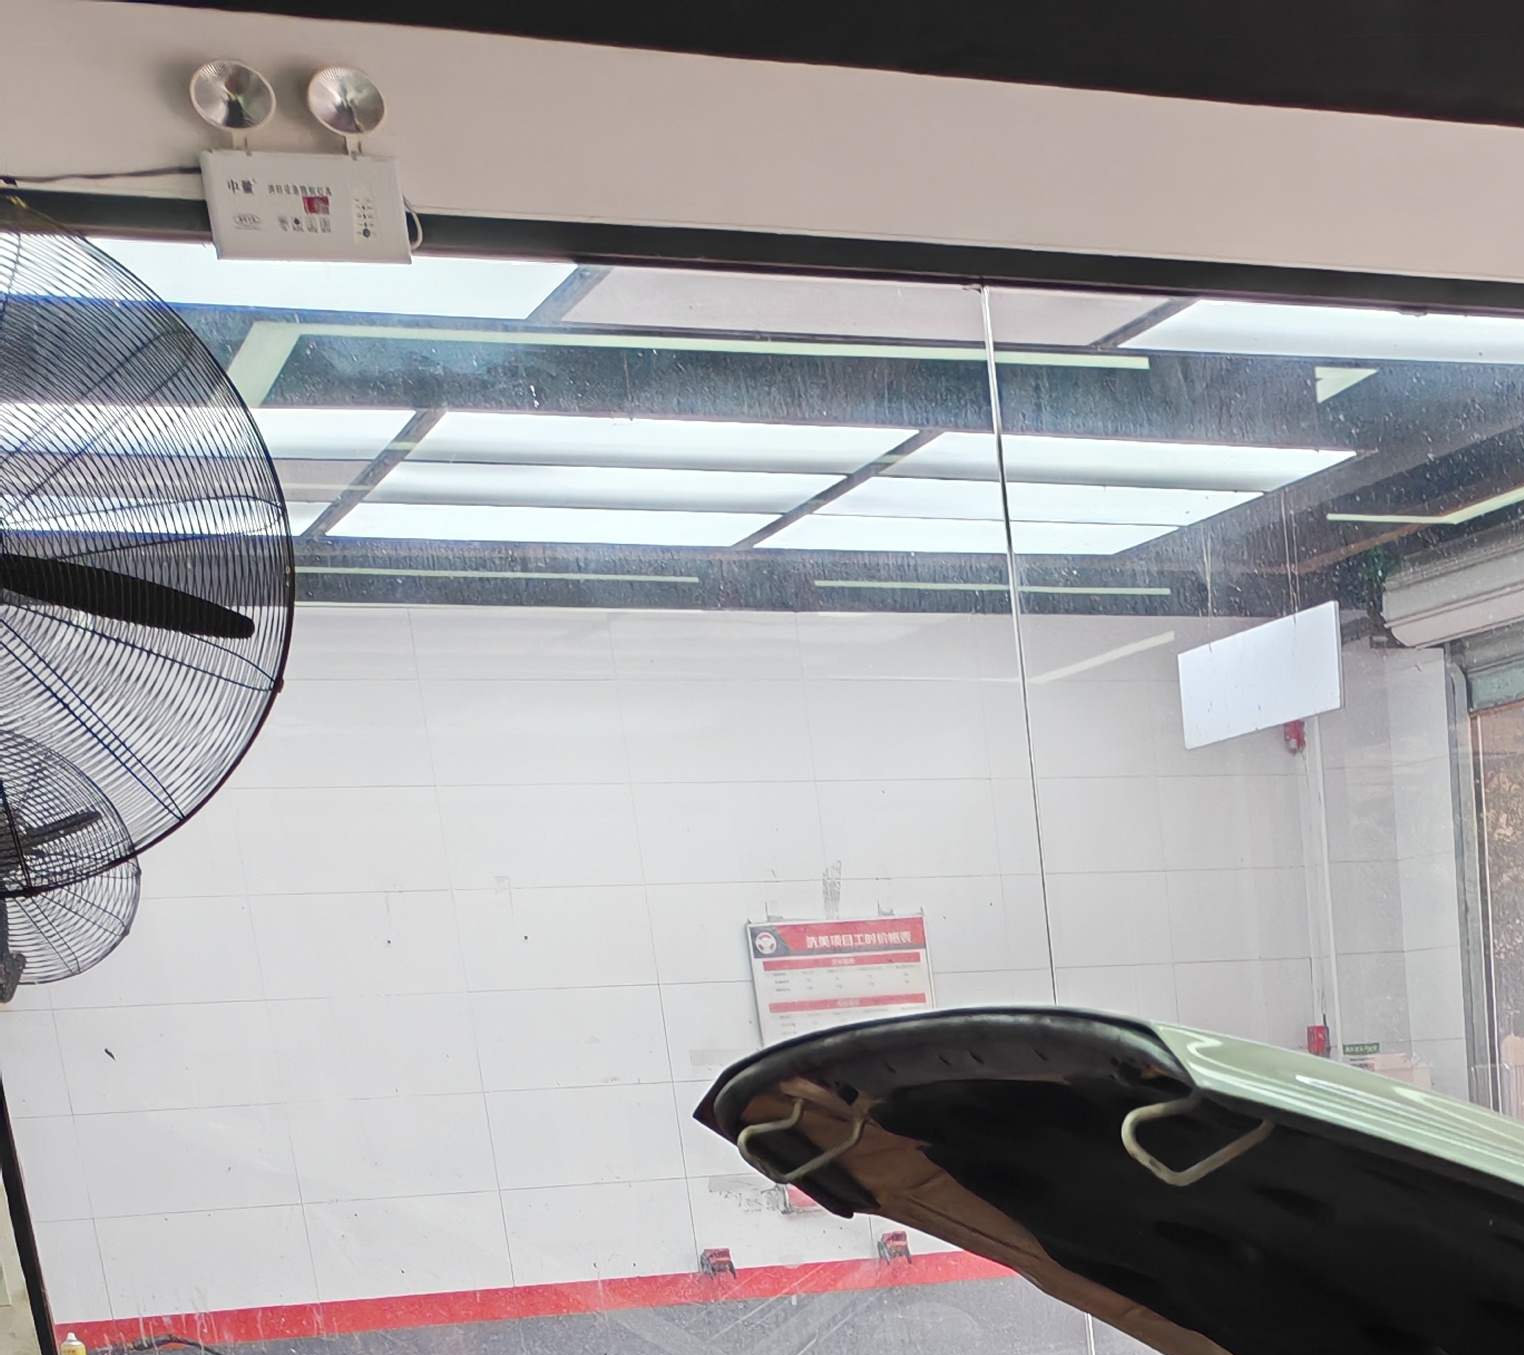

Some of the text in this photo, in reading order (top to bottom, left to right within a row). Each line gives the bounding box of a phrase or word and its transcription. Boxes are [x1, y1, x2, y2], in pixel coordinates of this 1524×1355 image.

[805, 931, 912, 949] 洗美项目工时价格表
